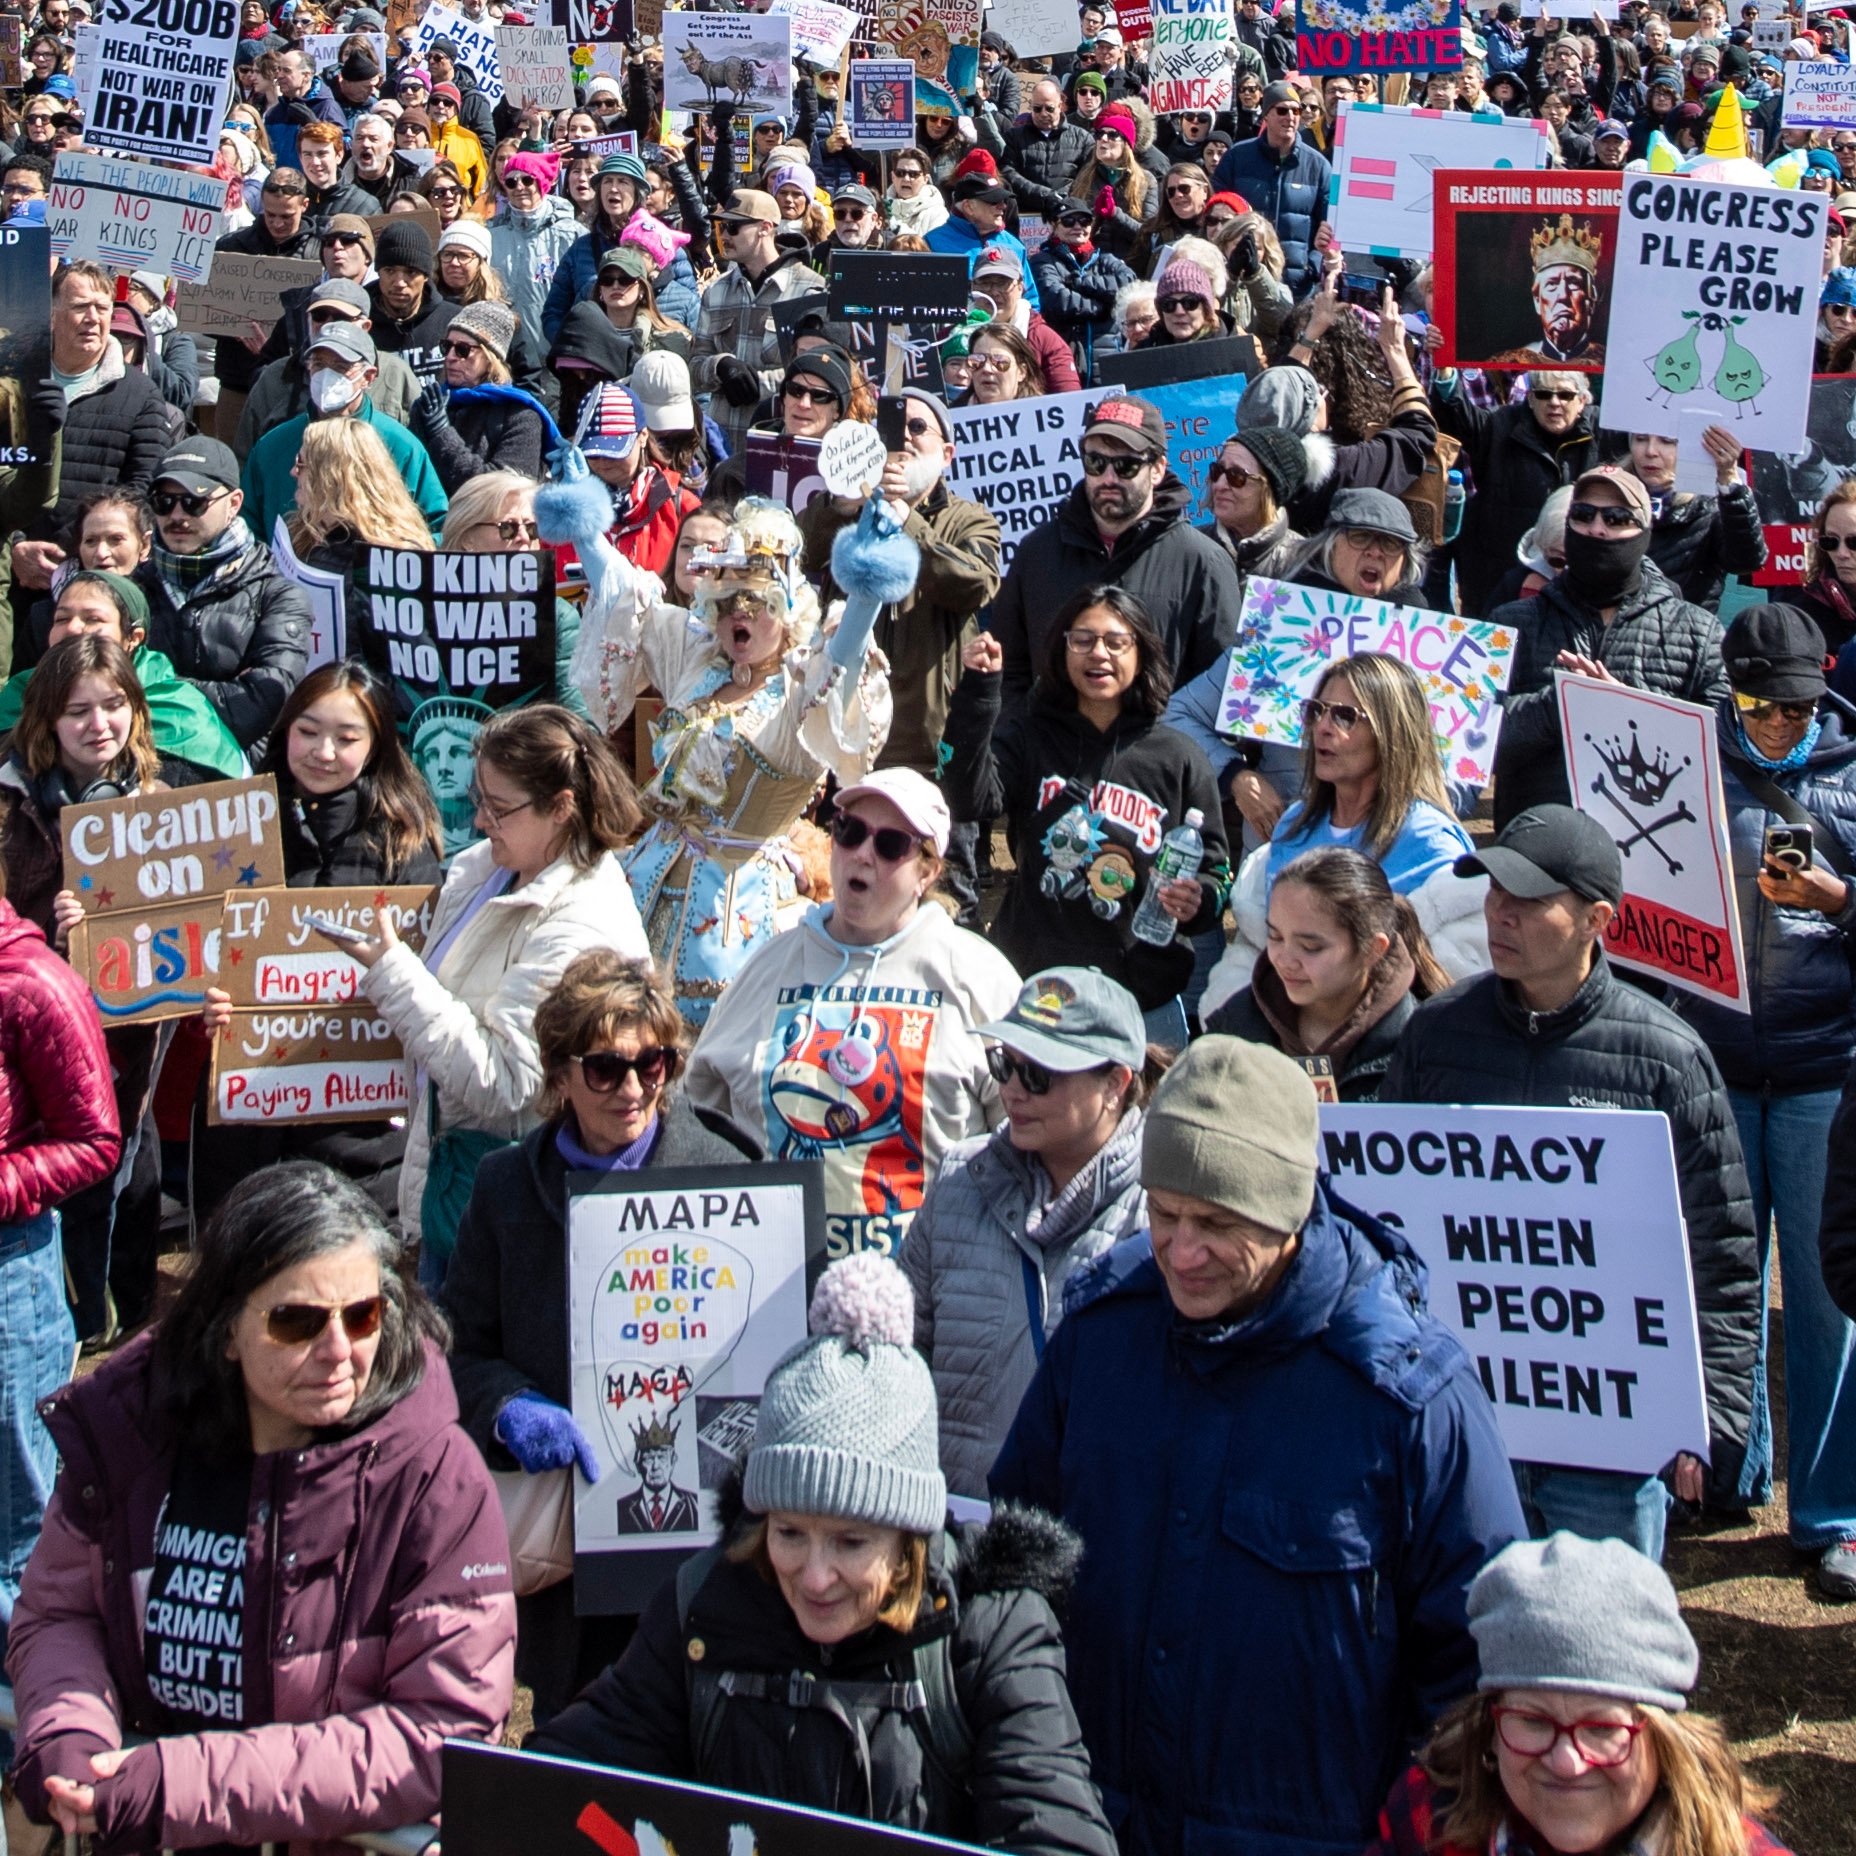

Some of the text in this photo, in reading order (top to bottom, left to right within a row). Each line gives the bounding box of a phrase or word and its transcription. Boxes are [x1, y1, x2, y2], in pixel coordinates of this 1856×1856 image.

[102, 38, 228, 78] HEALTHCARE
[1164, 44, 1201, 79] HAVE
[1297, 28, 1461, 68] NO HATE
[100, 68, 216, 106] NOT WAR ON
[1798, 63, 1851, 76] LOYALTY
[1150, 78, 1211, 114] AGAINST
[58, 160, 224, 206] WE THE PEOPLE WANT
[52, 186, 212, 234] NO NO NO
[1628, 181, 1820, 239] CONGRESS
[1640, 232, 1779, 276] PLEASE
[1700, 275, 1804, 315] GROW
[972, 472, 1073, 507] WORLD
[369, 548, 539, 593] NO KING
[372, 600, 538, 639] NO WAR
[389, 640, 520, 686] NO ICE
[1321, 615, 1488, 689] PEACE
[70, 789, 276, 866] Cleanup
[138, 854, 204, 898] on
[226, 898, 270, 938] If
[386, 902, 432, 936] not
[261, 964, 356, 1003] Angry
[618, 1192, 759, 1232] MAPA
[625, 1243, 708, 1266] make
[1443, 1215, 1597, 1268] WHEN
[621, 1318, 706, 1344] again
[165, 1568, 224, 1605] ARE
[160, 1643, 212, 1678] BUT
